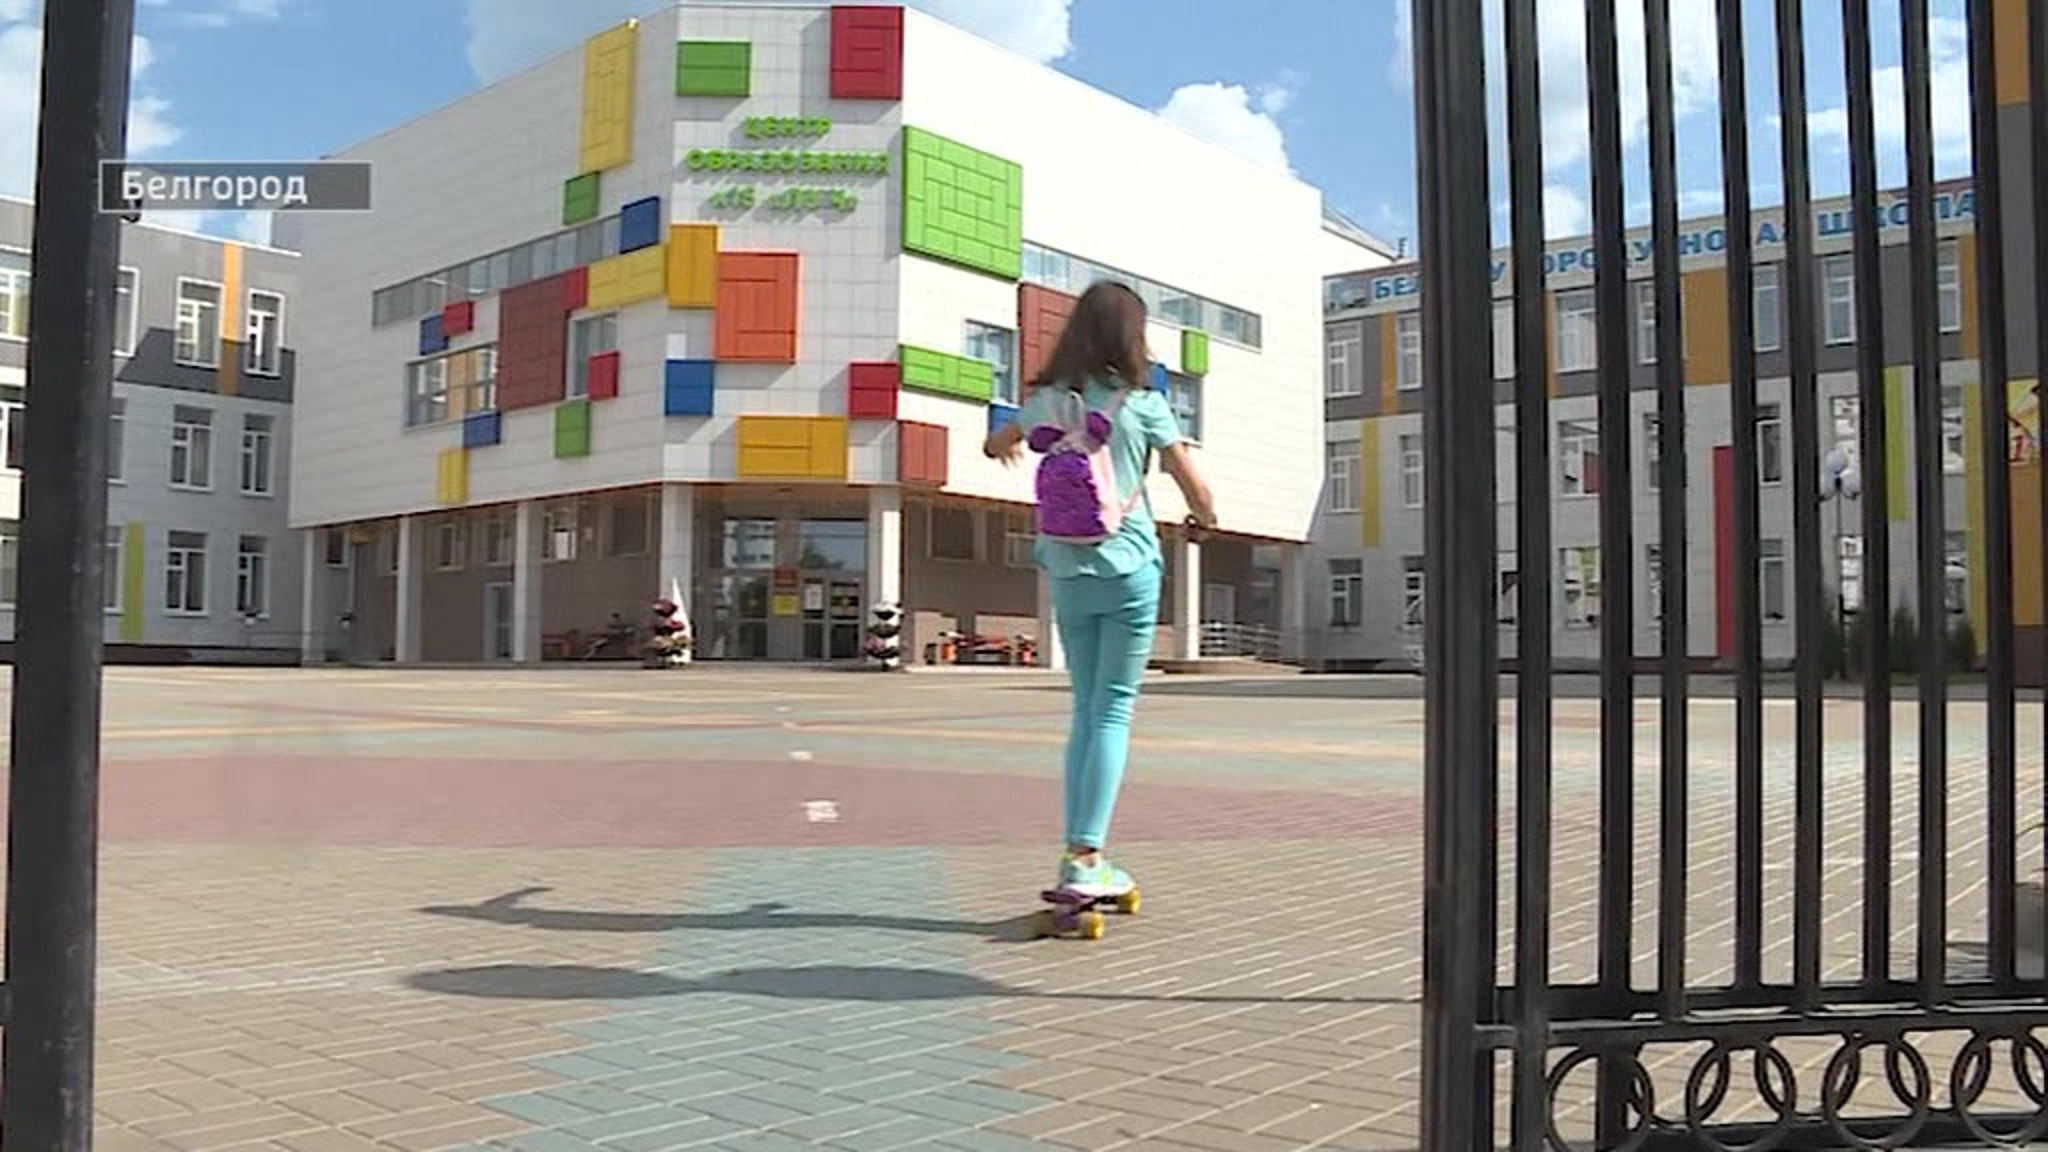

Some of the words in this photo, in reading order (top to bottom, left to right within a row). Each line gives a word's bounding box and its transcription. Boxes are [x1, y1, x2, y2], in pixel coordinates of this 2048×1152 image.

[744, 117, 831, 138] ЦЕНТР
[686, 149, 889, 174] ОБРАЗОВАНИЯ
[1678, 222, 1788, 255] НОА
